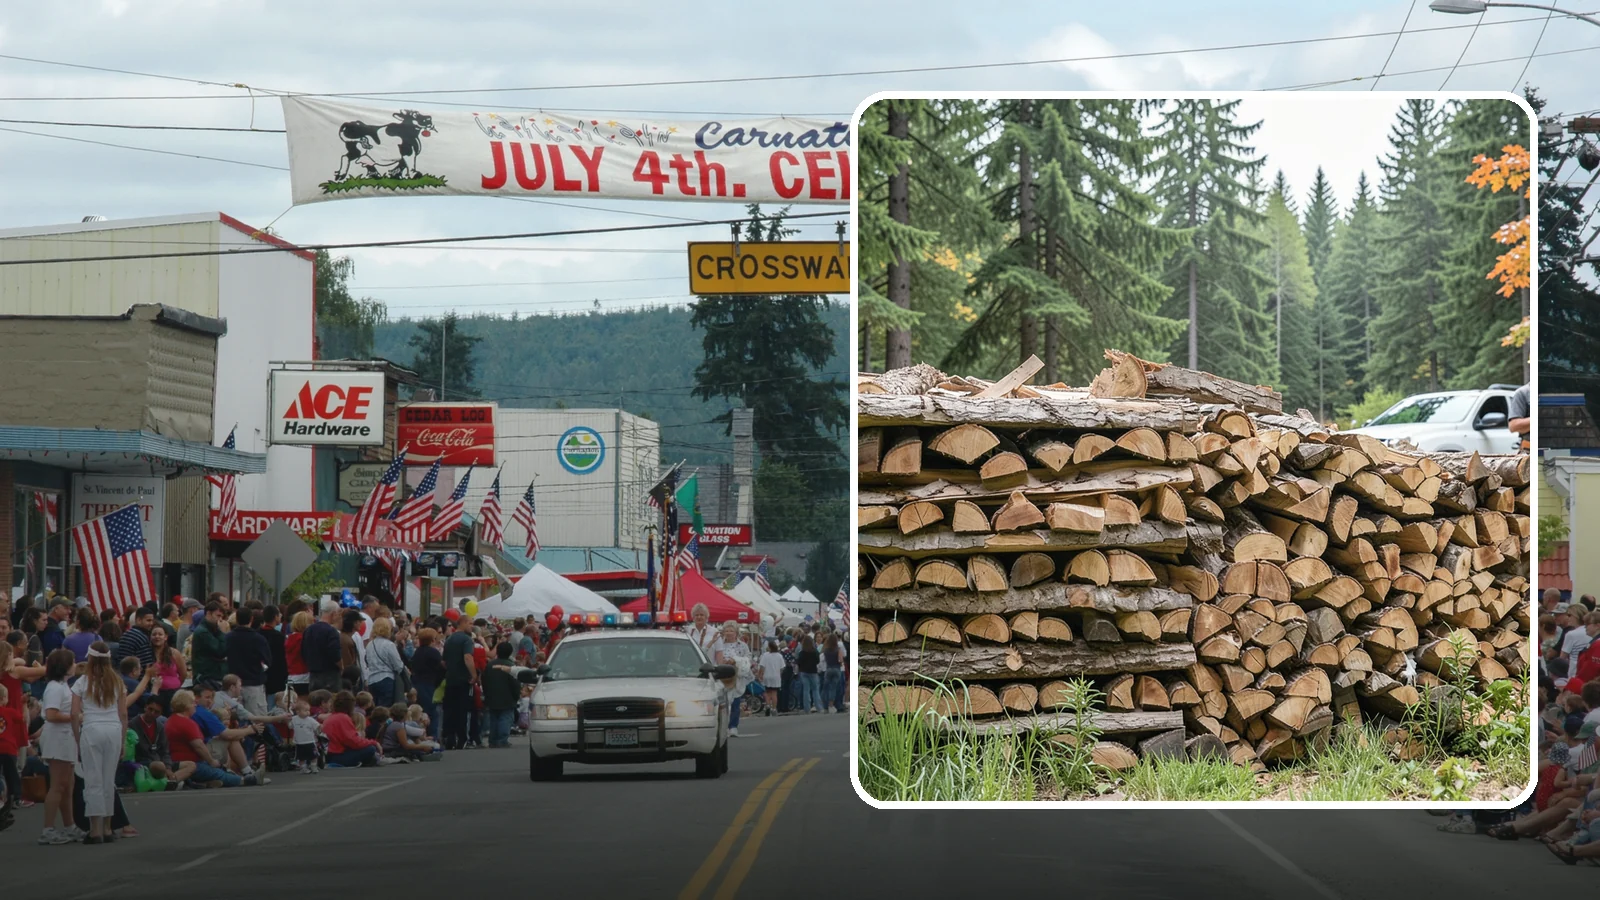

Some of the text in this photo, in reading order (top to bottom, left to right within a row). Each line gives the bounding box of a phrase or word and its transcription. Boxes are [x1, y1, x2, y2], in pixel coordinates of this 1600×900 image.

[481, 141, 605, 192] JULY
[633, 149, 746, 198] 4th.
[697, 254, 850, 280] CROSSWA
[283, 380, 373, 419] ACE
[406, 410, 453, 421] CEDAR
[283, 421, 371, 436] Hardware
[416, 427, 477, 447] Coca-Cola
[353, 467, 385, 478] Simpl
[96, 484, 124, 495] Vincent
[126, 485, 136, 495] de
[138, 486, 155, 496] Paul
[80, 503, 154, 522] THT
[688, 526, 741, 535] CRNATION
[699, 535, 730, 543] GLASS
